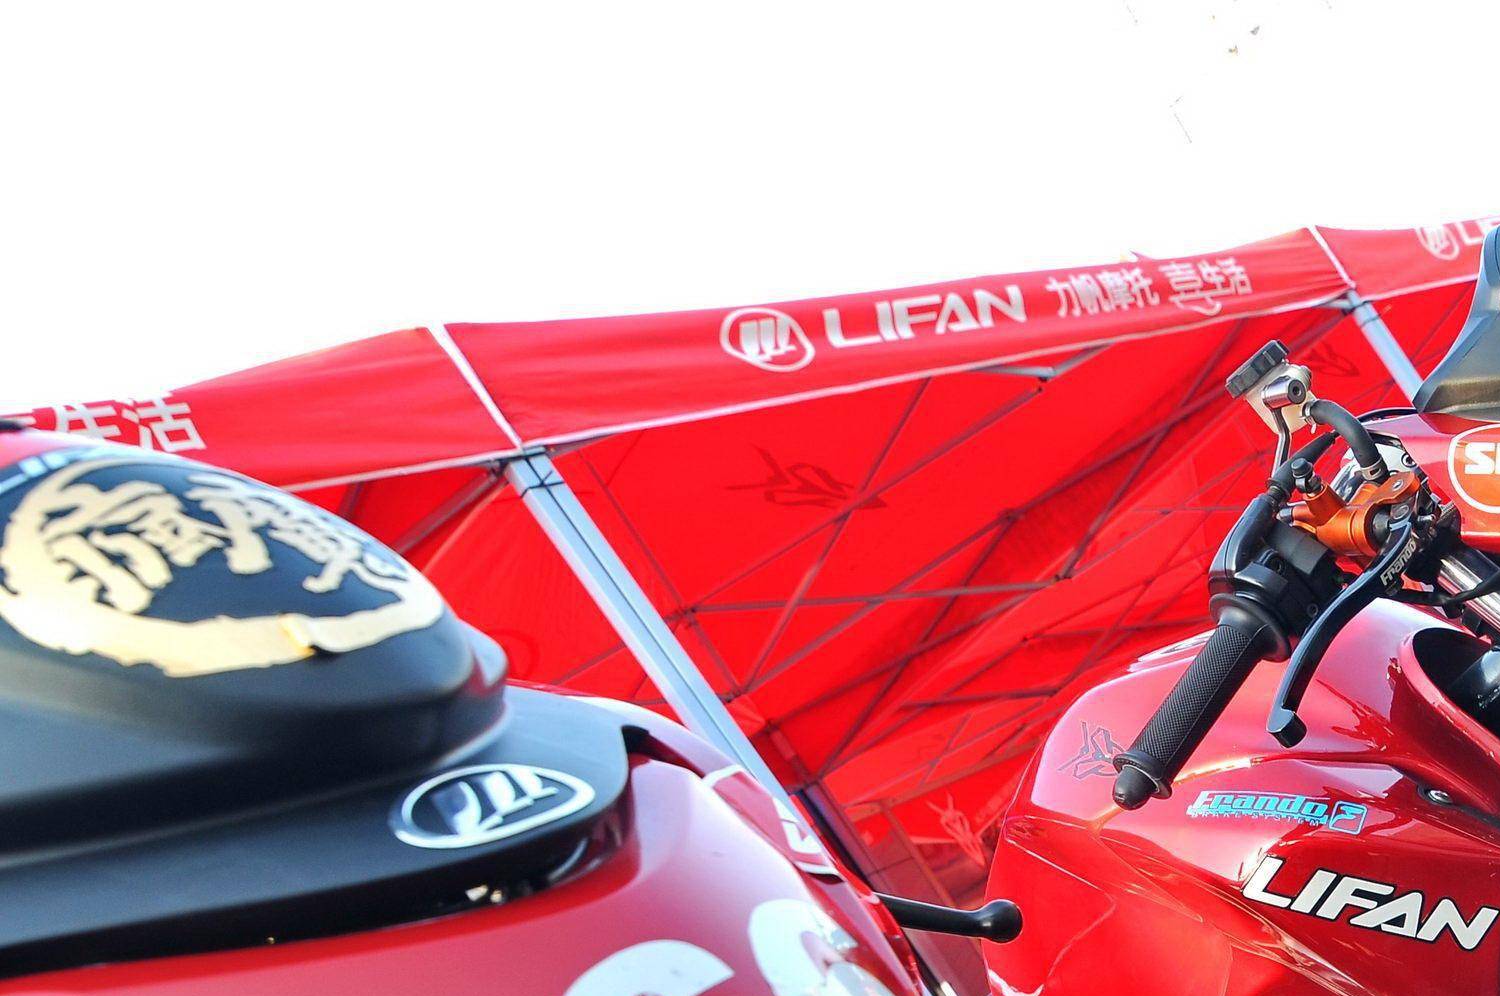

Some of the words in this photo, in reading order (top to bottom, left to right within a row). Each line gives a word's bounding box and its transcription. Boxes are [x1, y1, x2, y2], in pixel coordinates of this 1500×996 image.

[822, 285, 1027, 348] LIFAN
[18, 392, 208, 453] 生活
[1241, 855, 1500, 950] LIFAN
